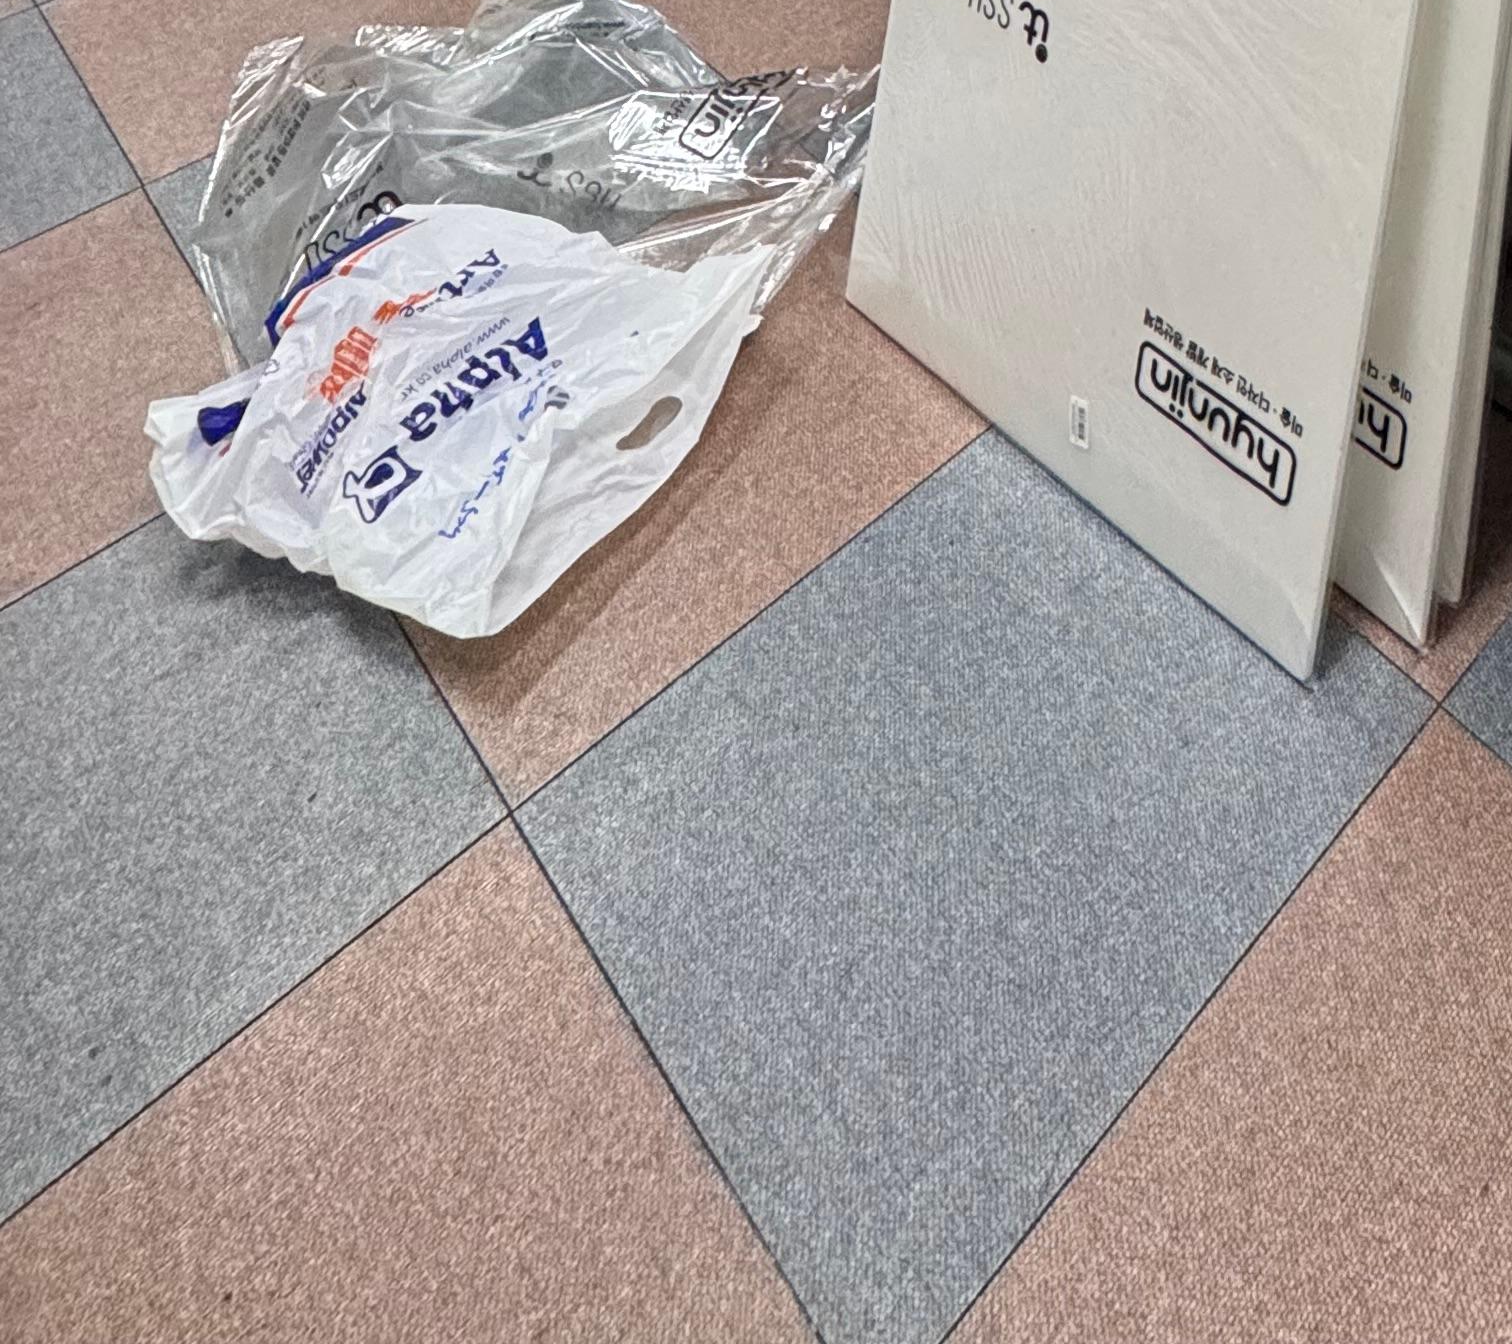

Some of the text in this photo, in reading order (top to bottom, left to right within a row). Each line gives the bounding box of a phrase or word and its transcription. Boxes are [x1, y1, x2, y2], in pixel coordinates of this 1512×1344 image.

[397, 316, 548, 444] Alpha
[1141, 307, 1303, 438] 미술 디자인 소재 개발 생산업체
[1148, 358, 1280, 488] hyunjin
